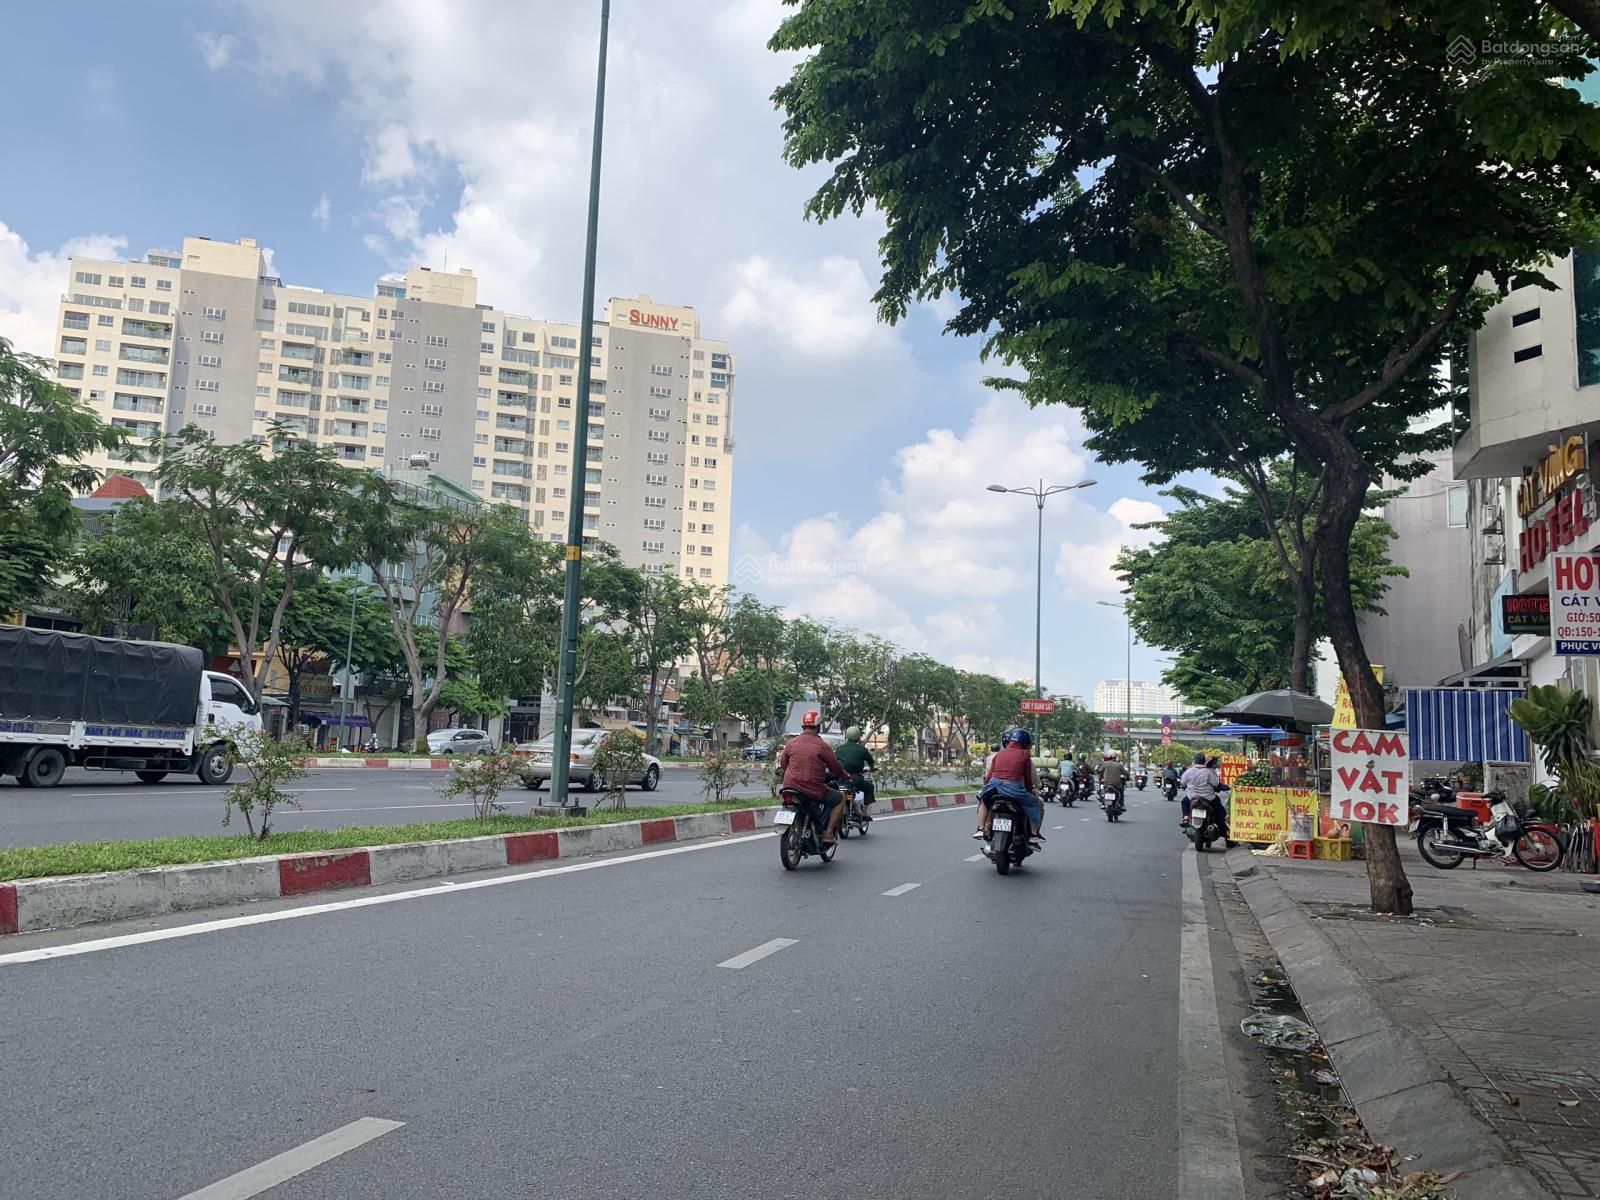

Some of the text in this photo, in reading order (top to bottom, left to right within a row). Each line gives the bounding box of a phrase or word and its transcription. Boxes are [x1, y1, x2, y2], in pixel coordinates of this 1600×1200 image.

[629, 309, 679, 329] SUNNY
[1519, 488, 1589, 573] HOTEL
[1561, 593, 1590, 607] CÁT
[1561, 641, 1589, 652] PHỤC
[1333, 730, 1407, 758] CAM
[1221, 754, 1246, 764] CAM
[1222, 776, 1236, 785] 10
[1337, 760, 1404, 795] VẮT
[1339, 799, 1400, 824] 10K
